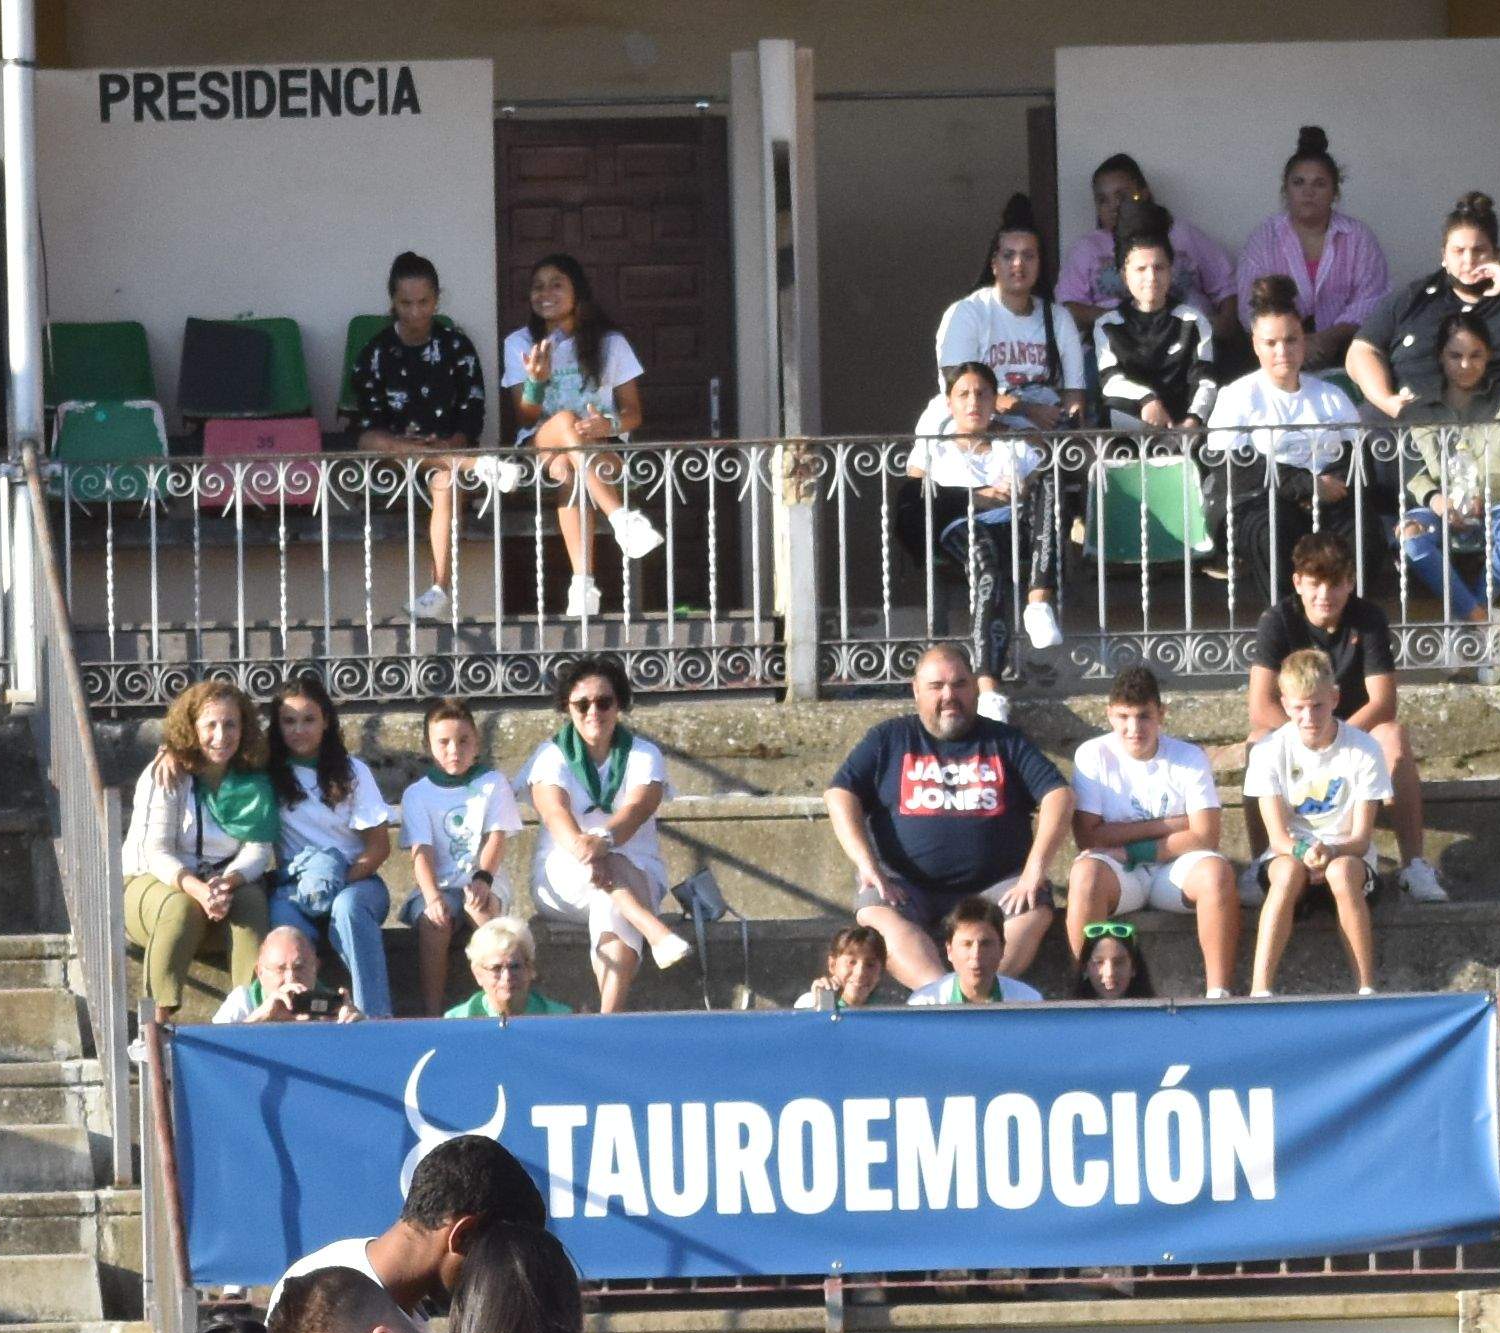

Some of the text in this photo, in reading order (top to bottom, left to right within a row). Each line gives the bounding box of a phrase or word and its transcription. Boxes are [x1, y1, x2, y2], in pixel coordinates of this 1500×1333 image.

[99, 65, 421, 123] PRESIDENCIA
[905, 788, 998, 811] JONES
[531, 1065, 1277, 1220] TAUROEMOCIÓN
